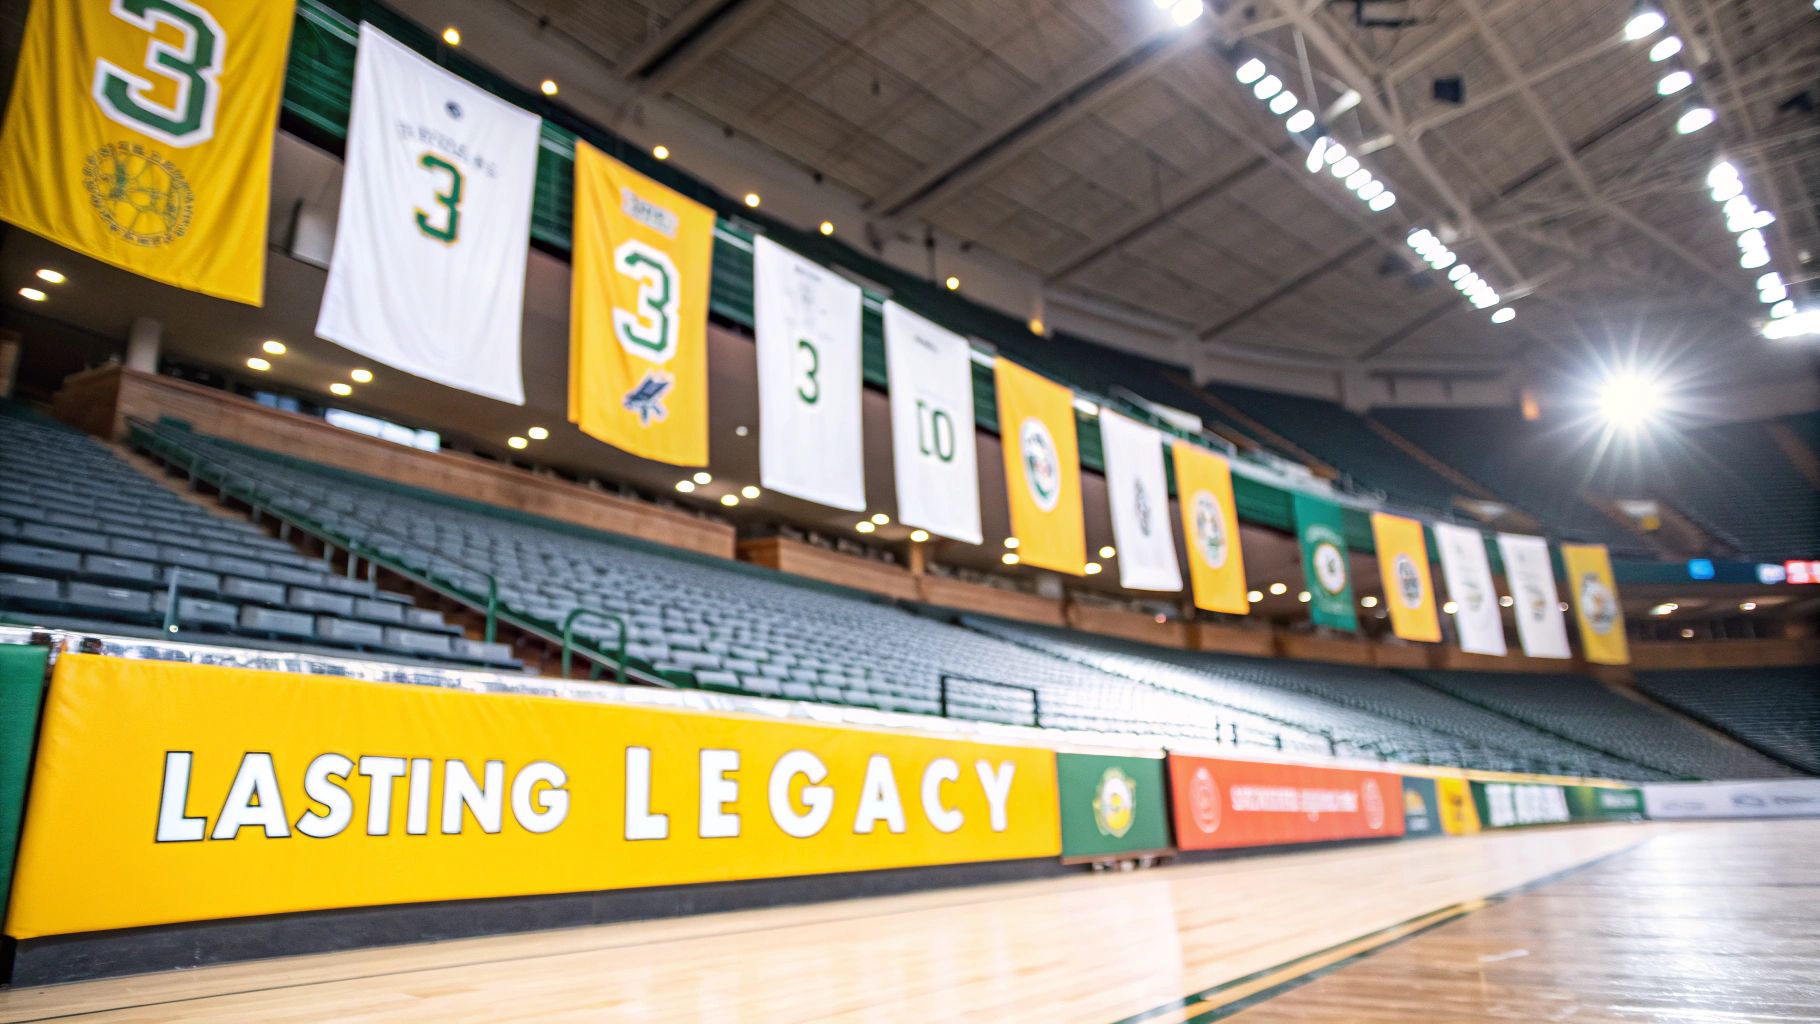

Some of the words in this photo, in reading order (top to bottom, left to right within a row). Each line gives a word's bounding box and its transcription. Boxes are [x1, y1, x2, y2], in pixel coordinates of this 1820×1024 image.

[93, 0, 227, 148] 3
[414, 151, 465, 246] 3
[612, 239, 680, 364] 3
[797, 338, 819, 405] 3
[154, 750, 570, 843] LASTING
[624, 746, 1016, 840] LEGACY
